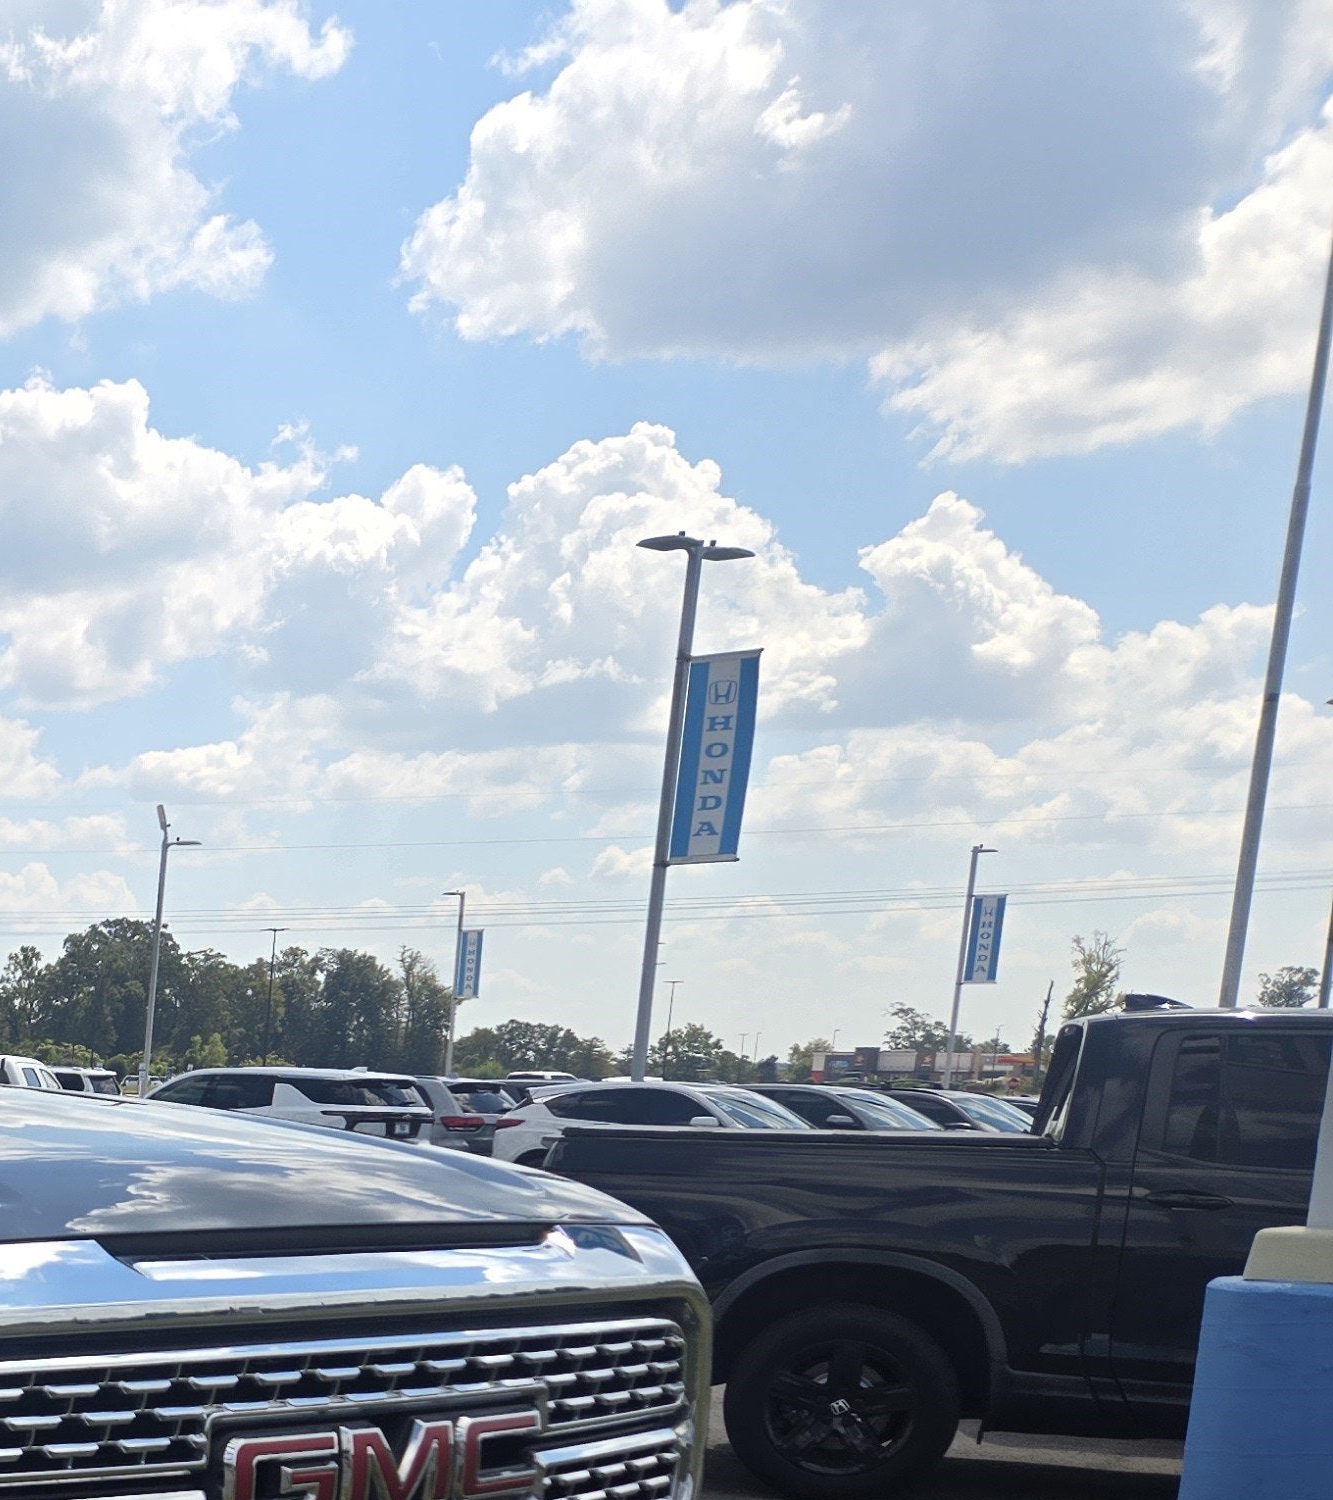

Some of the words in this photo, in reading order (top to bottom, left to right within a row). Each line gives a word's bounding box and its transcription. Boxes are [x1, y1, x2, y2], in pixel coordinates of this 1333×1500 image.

[692, 715, 734, 837] HONDA
[465, 949, 477, 990] HONDA
[975, 921, 993, 973] HONDA
